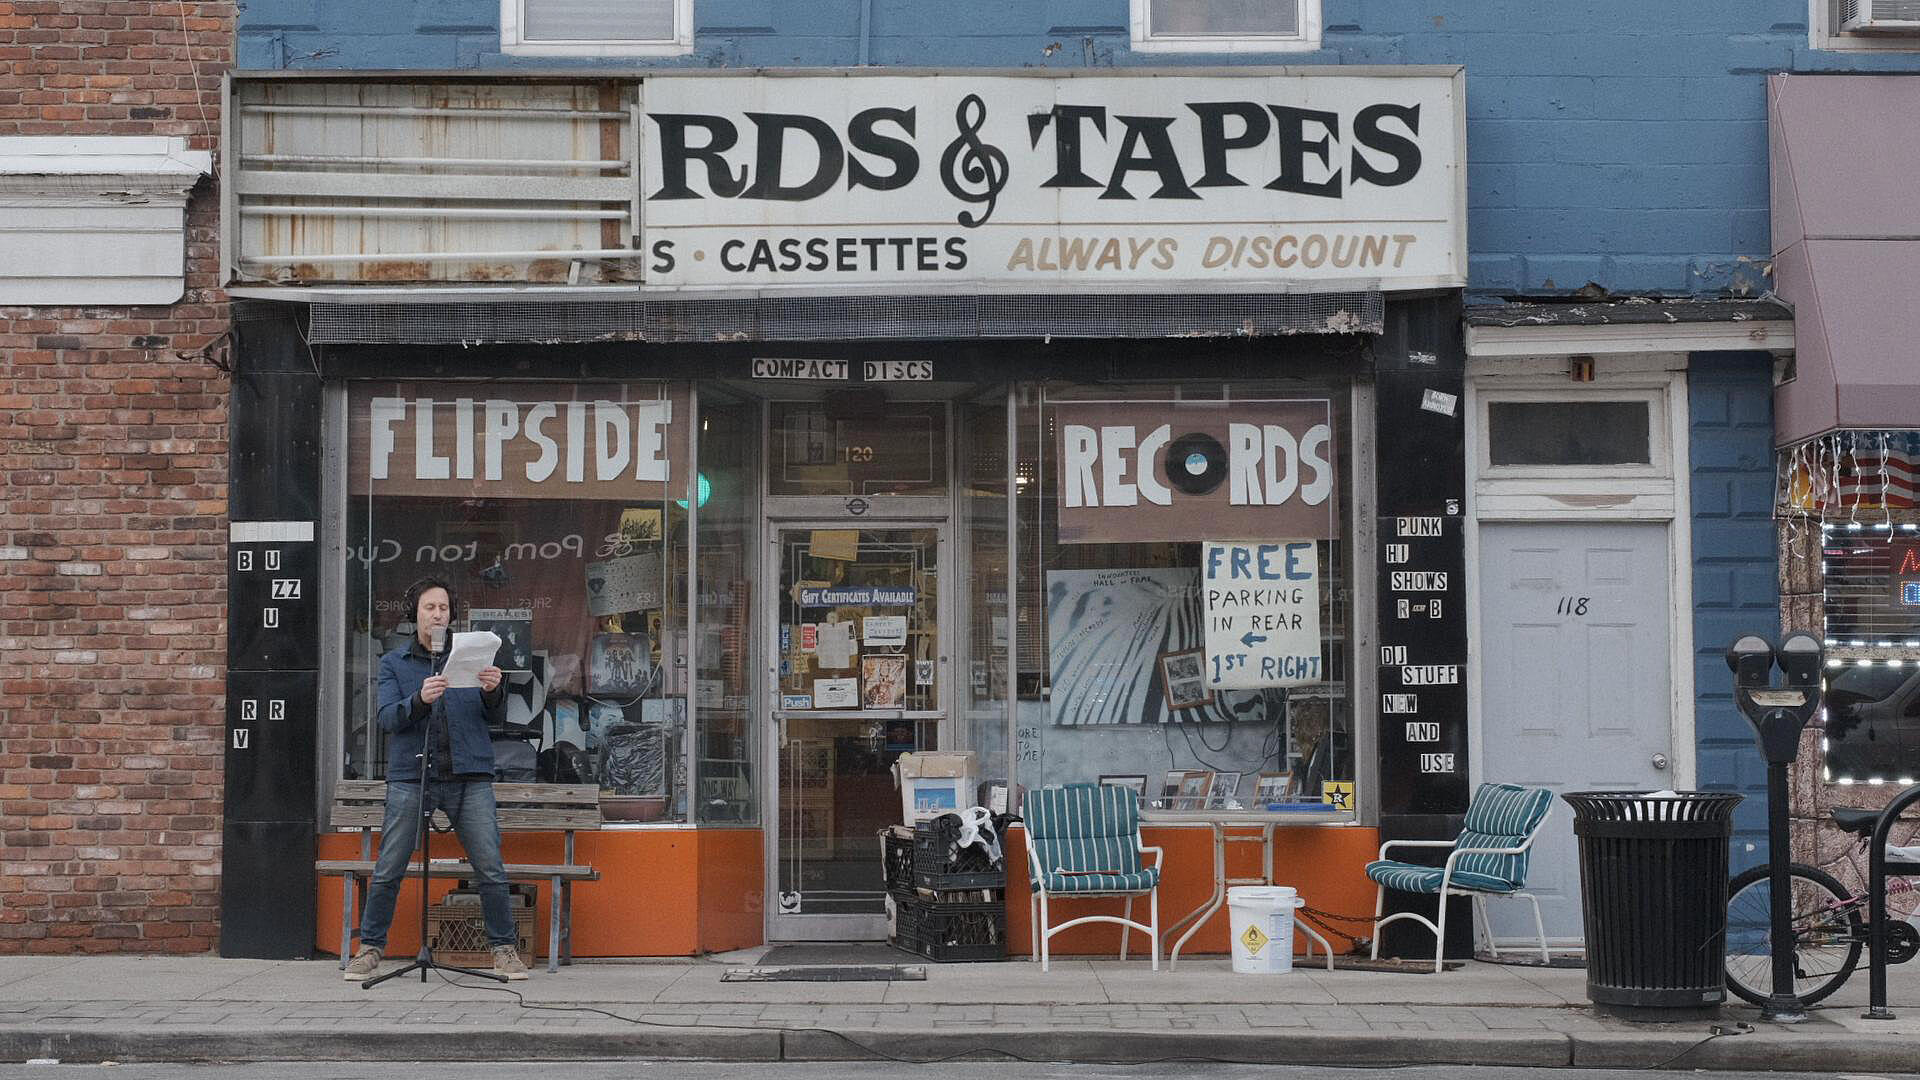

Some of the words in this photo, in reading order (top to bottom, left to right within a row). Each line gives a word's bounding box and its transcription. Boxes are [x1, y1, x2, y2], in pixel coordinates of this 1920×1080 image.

[648, 106, 920, 201] RDS
[1027, 101, 1422, 200] TAPES
[652, 240, 675, 273] S
[720, 237, 968, 272] CASSETTES
[1007, 237, 1179, 271] ALWAYS
[1202, 234, 1416, 270] DISCOUNT
[754, 360, 847, 378] COMPACT
[866, 362, 931, 380] DISCS
[371, 397, 672, 483] FLIPSIDE
[845, 447, 872, 462] 120
[1399, 518, 1441, 536] PUNK
[1207, 543, 1312, 580] FREE
[1392, 573, 1447, 590] SHOWS
[802, 589, 819, 604] GIFT
[1209, 588, 1304, 611] PARKING
[1398, 600, 1409, 618] R
[1431, 600, 1441, 618] B
[1557, 597, 1590, 616] 118
[1213, 615, 1232, 632] IN
[1252, 613, 1302, 631] REAR
[1383, 647, 1406, 664] DJ
[1211, 654, 1247, 683] 1ST
[1261, 656, 1320, 680] RIGHT
[1403, 666, 1457, 684] STUFF
[242, 701, 256, 720] R
[270, 701, 284, 720] R
[784, 697, 809, 708] Push
[1384, 695, 1417, 712] NEW
[234, 729, 248, 749] V
[1018, 727, 1040, 738] ORE
[1407, 723, 1438, 740] AND
[1422, 754, 1454, 772] USE
